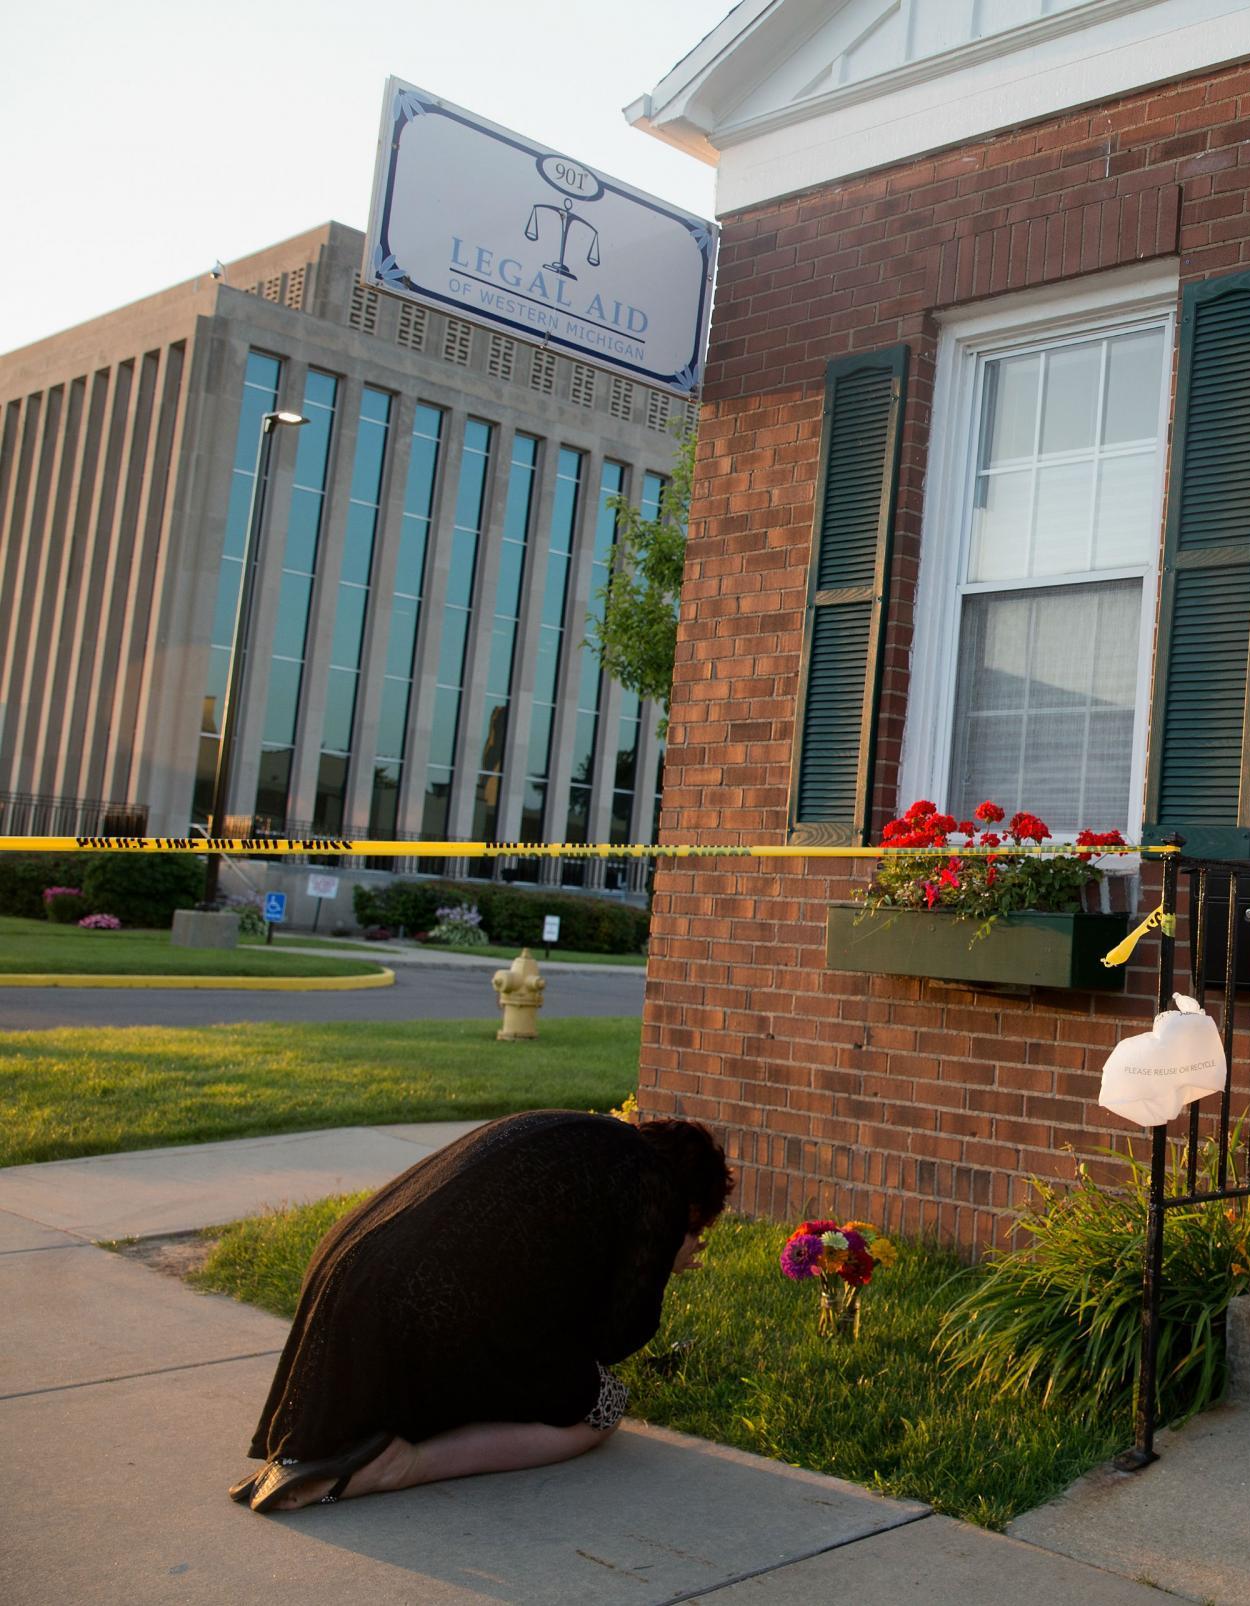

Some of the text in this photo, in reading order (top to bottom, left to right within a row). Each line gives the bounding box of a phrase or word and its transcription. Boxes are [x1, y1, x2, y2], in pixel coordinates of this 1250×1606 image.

[555, 162, 584, 191] 901
[451, 236, 649, 334] LEGAL AID
[448, 278, 646, 361] OF WESTERN MICHIGAN
[1124, 1066, 1153, 1076] PLEASE
[1154, 1066, 1177, 1077] REUSE
[1190, 1059, 1217, 1071] RECYCLE
